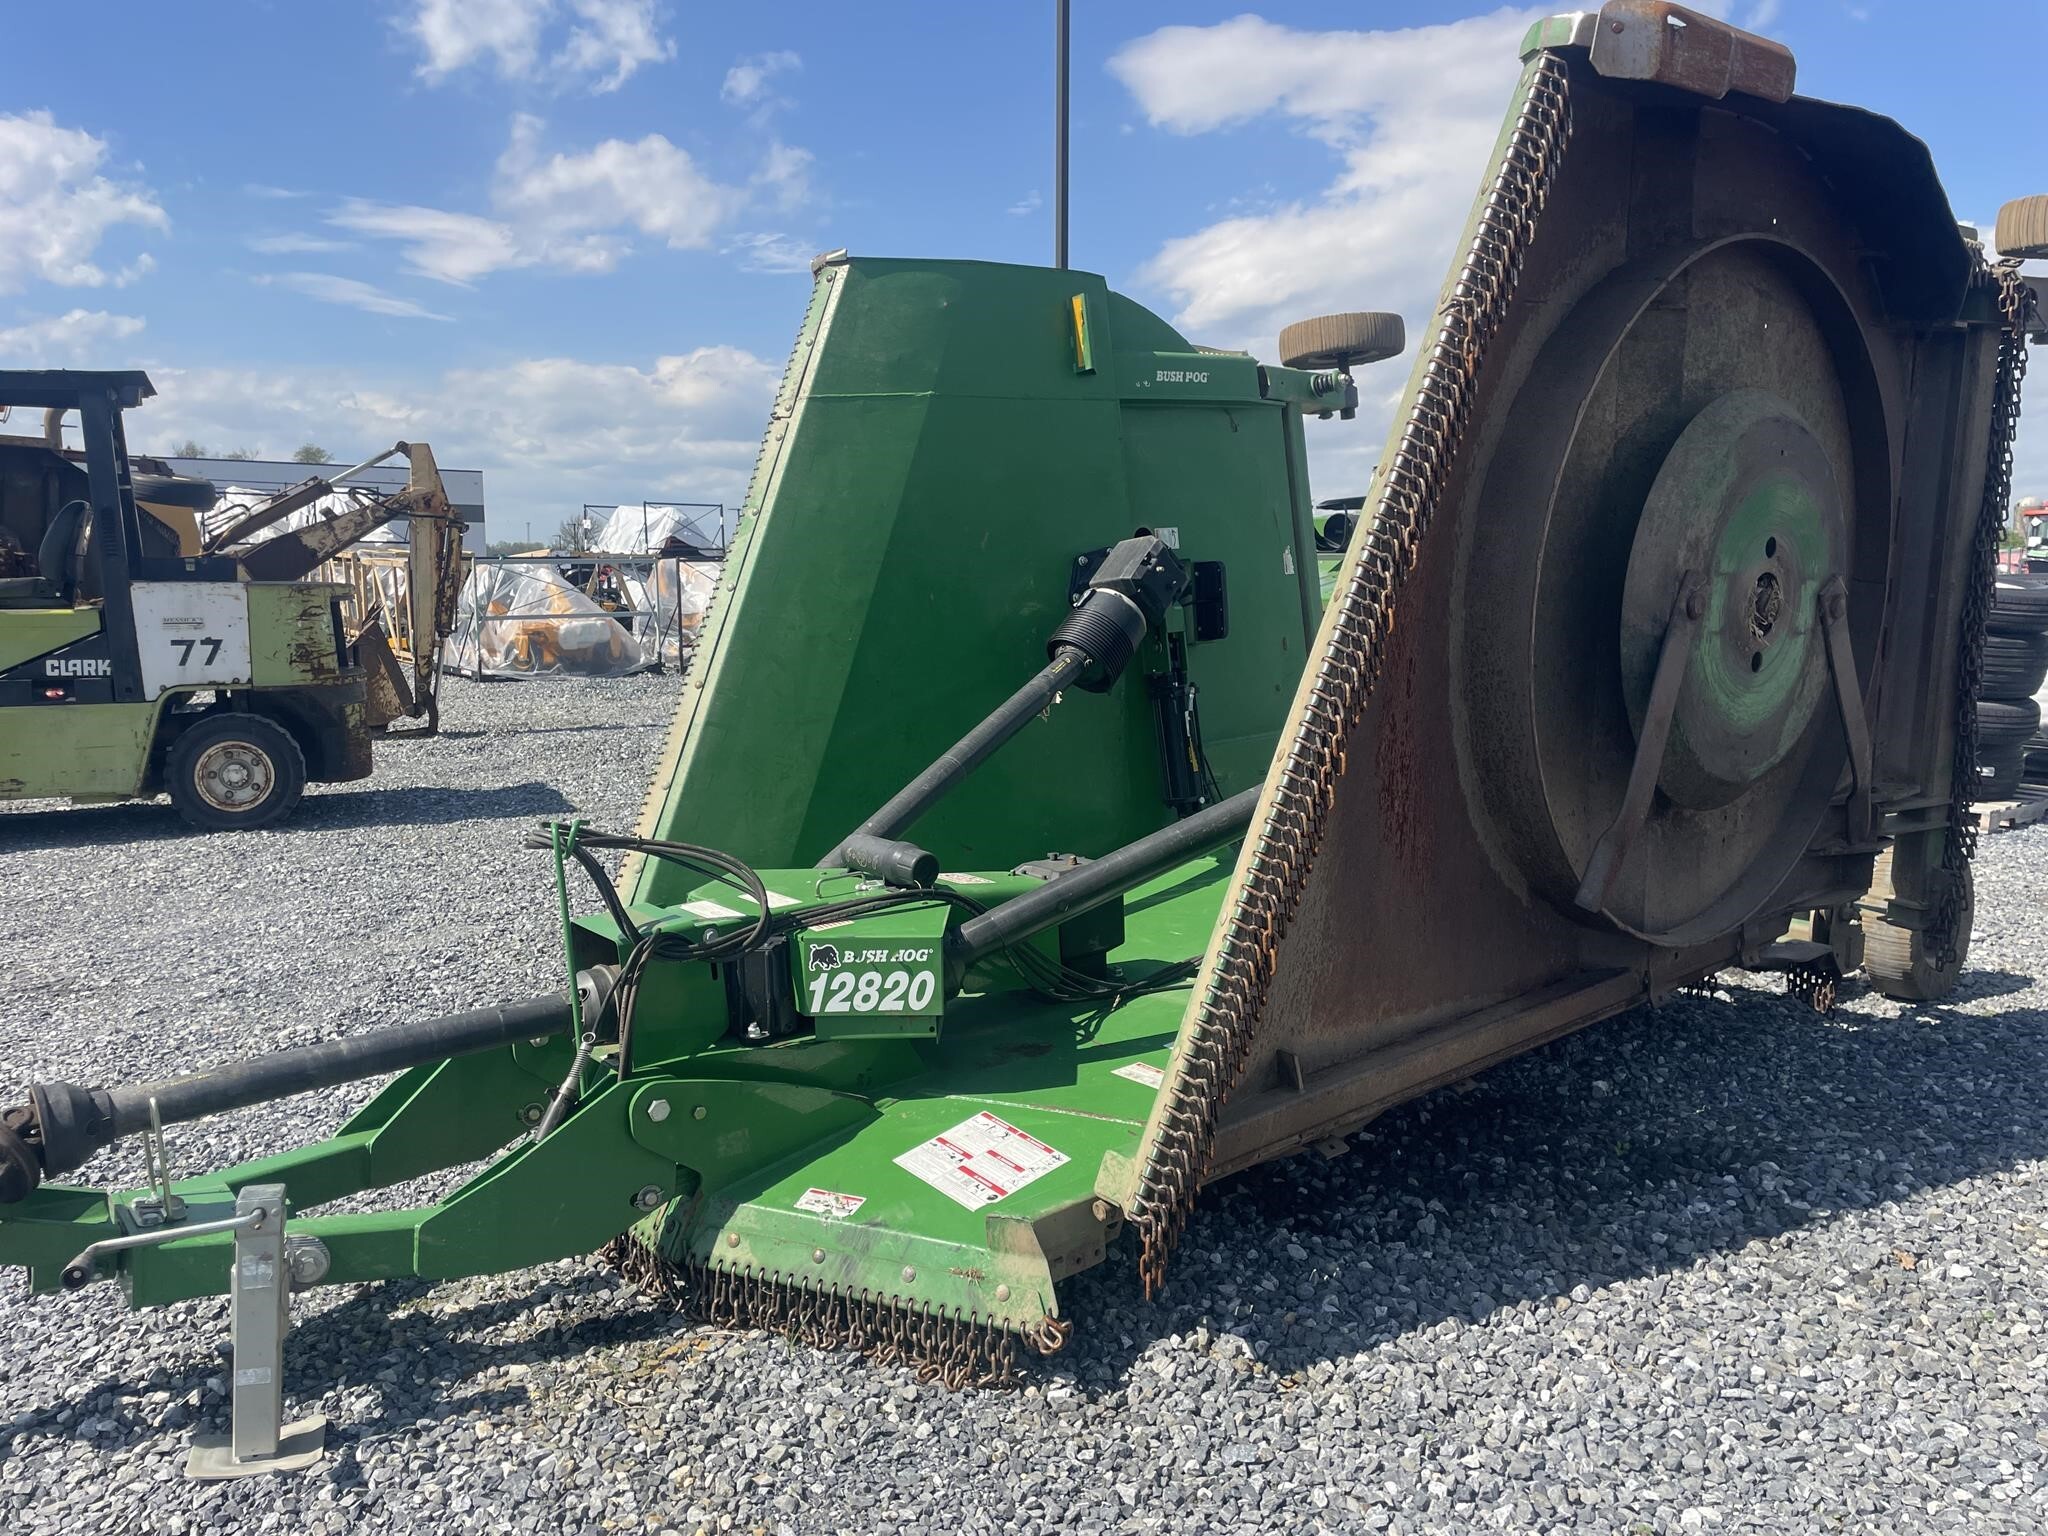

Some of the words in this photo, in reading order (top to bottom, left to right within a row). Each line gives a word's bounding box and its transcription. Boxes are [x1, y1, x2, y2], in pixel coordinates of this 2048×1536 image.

[1156, 371, 1183, 383] BUSH
[170, 639, 223, 666] 77
[45, 659, 112, 677] CLARK
[808, 970, 936, 1013] 12820
